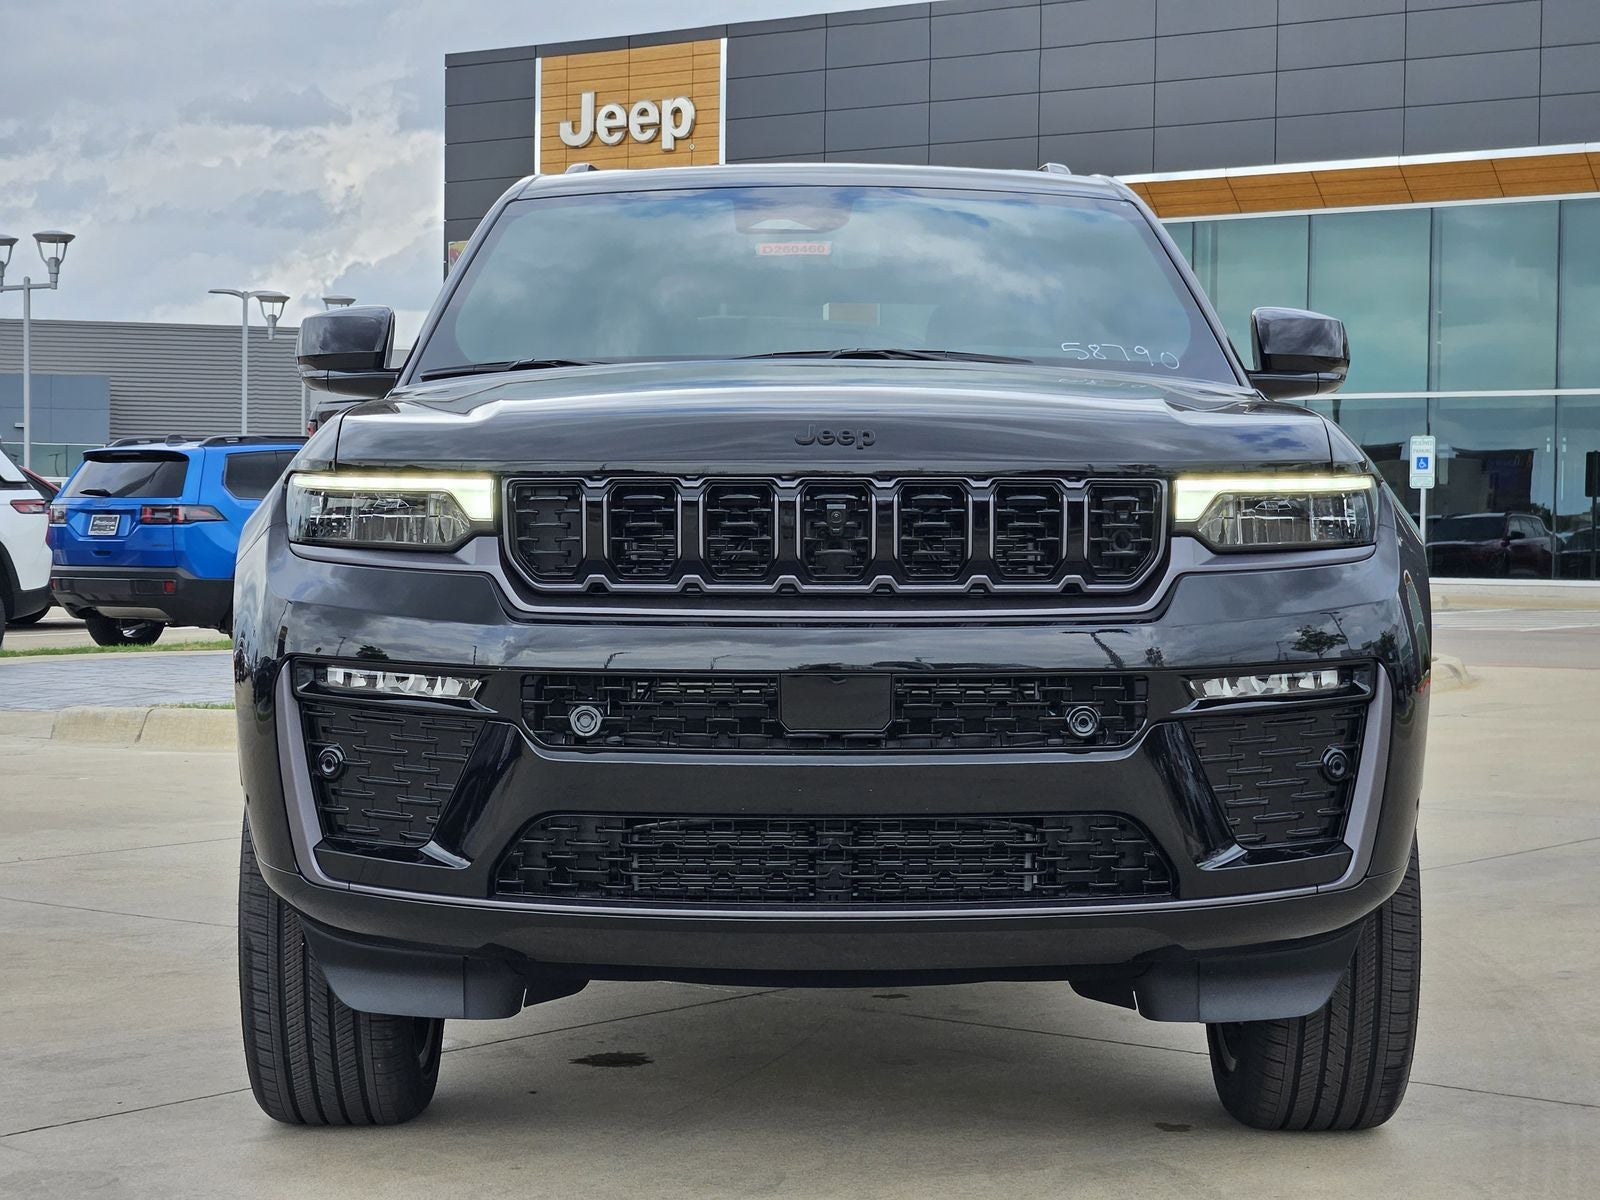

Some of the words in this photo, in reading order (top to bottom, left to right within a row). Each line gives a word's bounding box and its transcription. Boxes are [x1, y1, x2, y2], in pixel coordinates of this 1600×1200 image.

[559, 91, 696, 152] Jeep
[1061, 342, 1180, 370] 58790
[794, 423, 876, 450] Jeep
